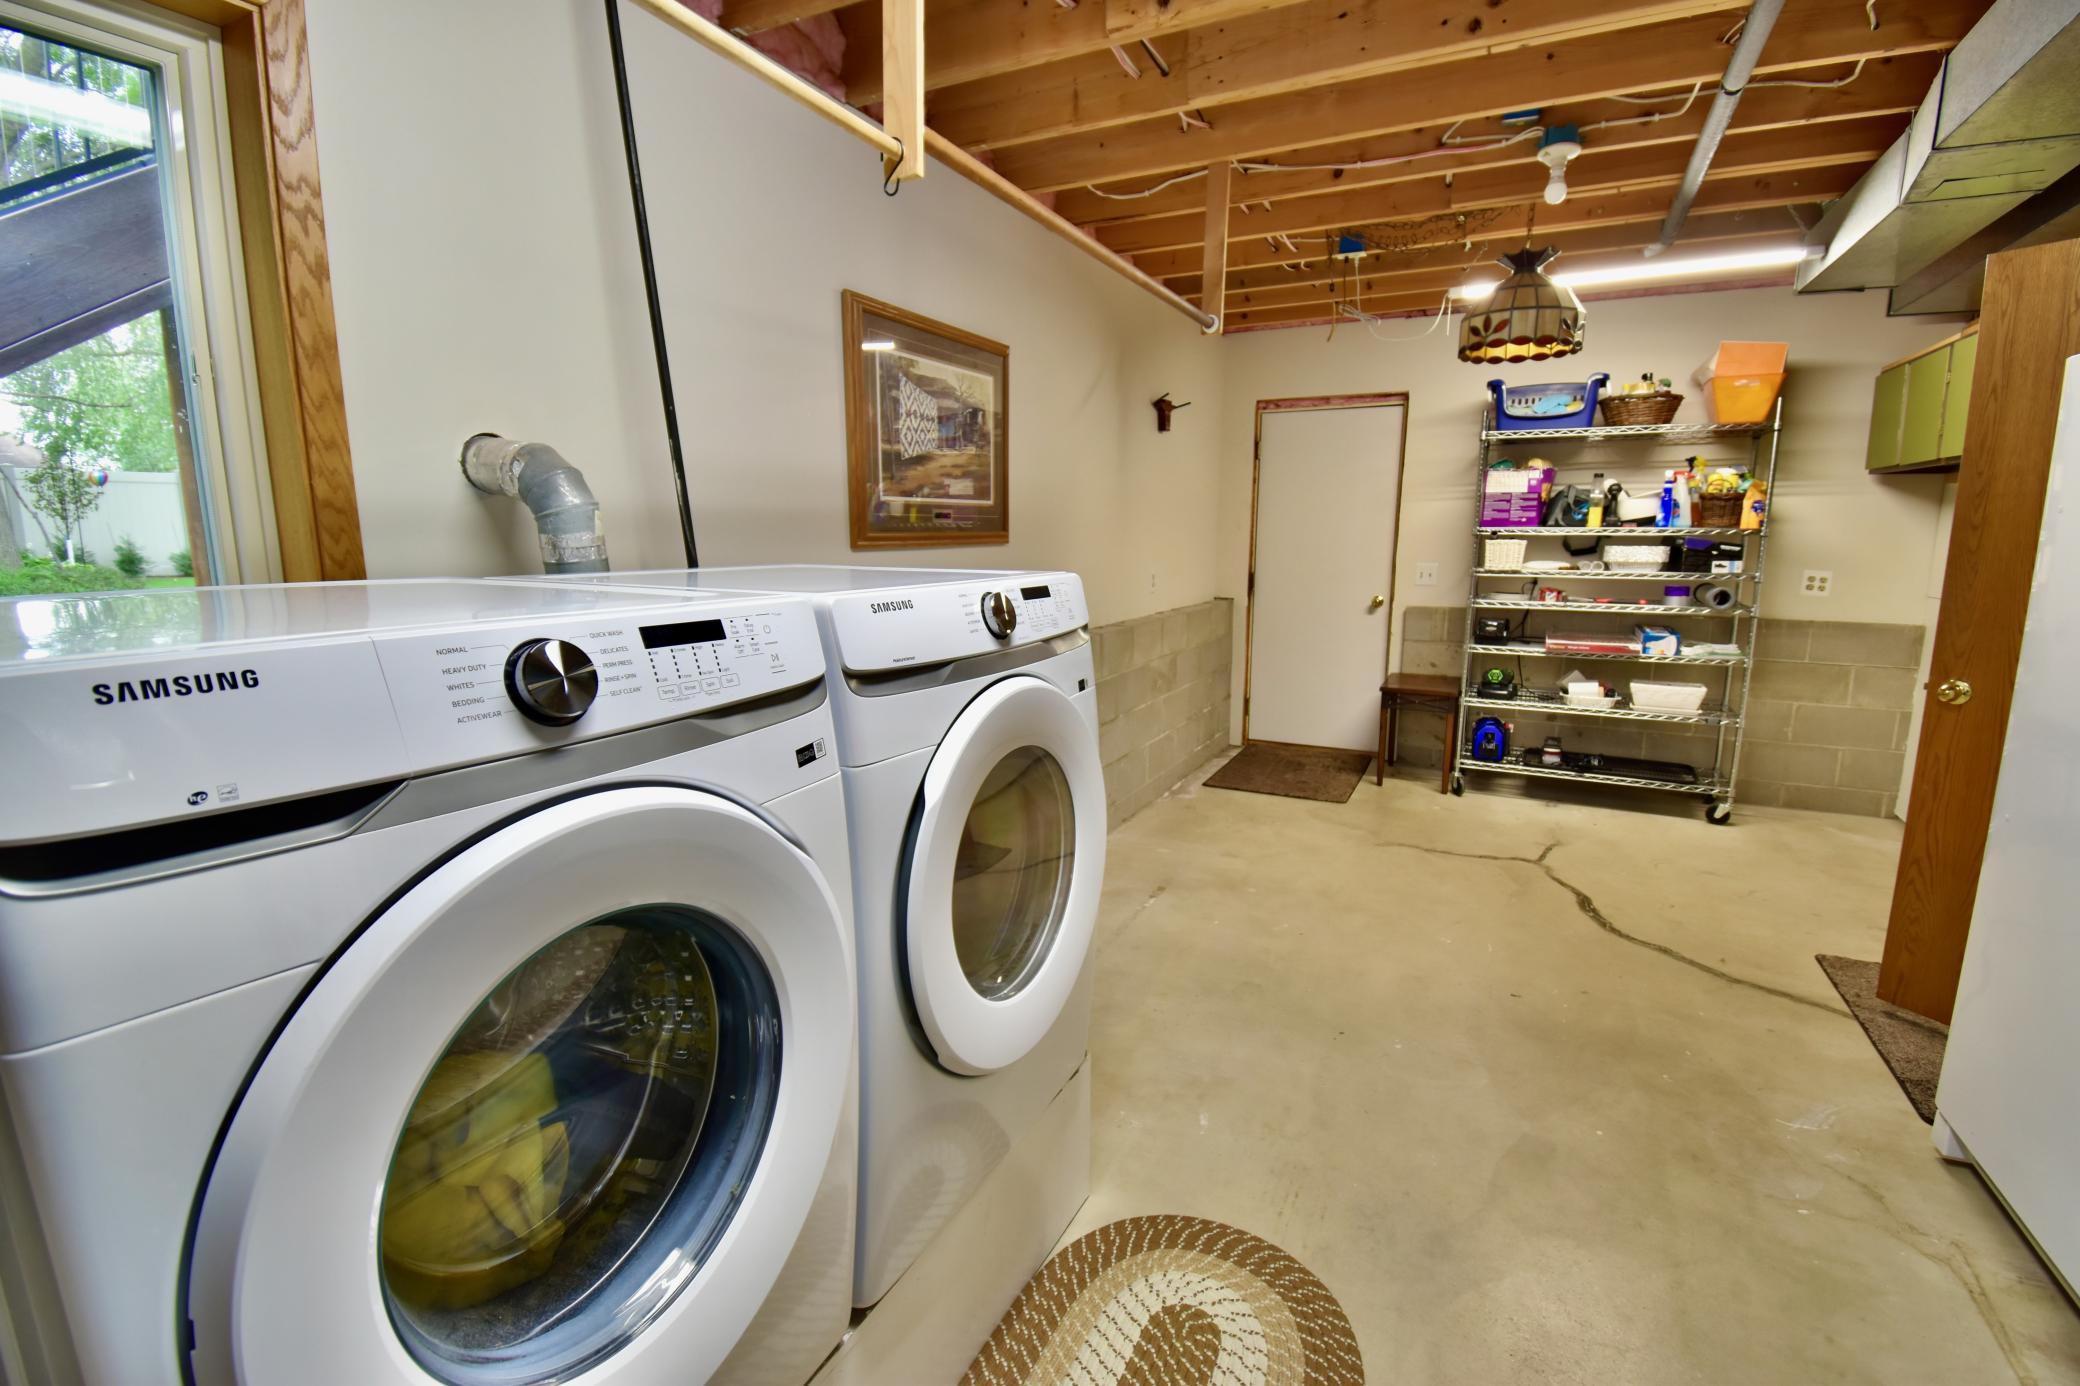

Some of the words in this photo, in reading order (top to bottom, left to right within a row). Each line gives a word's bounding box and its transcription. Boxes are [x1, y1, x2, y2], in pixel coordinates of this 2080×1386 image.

[871, 600, 914, 614] SAMSUNG
[589, 631, 606, 639] QUICK
[436, 646, 468, 656] NORMAL
[600, 646, 629, 655] DELICATES
[617, 659, 633, 667] PRESS
[442, 666, 466, 675] HEAVY
[467, 664, 486, 672] DUTY
[604, 675, 620, 683] RINSE
[624, 672, 637, 680] SPIN
[92, 668, 260, 706] SAMSUNG
[446, 681, 476, 692] WHITES
[610, 689, 622, 697] SELF
[451, 696, 486, 708] BEDDING
[457, 710, 503, 725] ACTIVEWEAR
